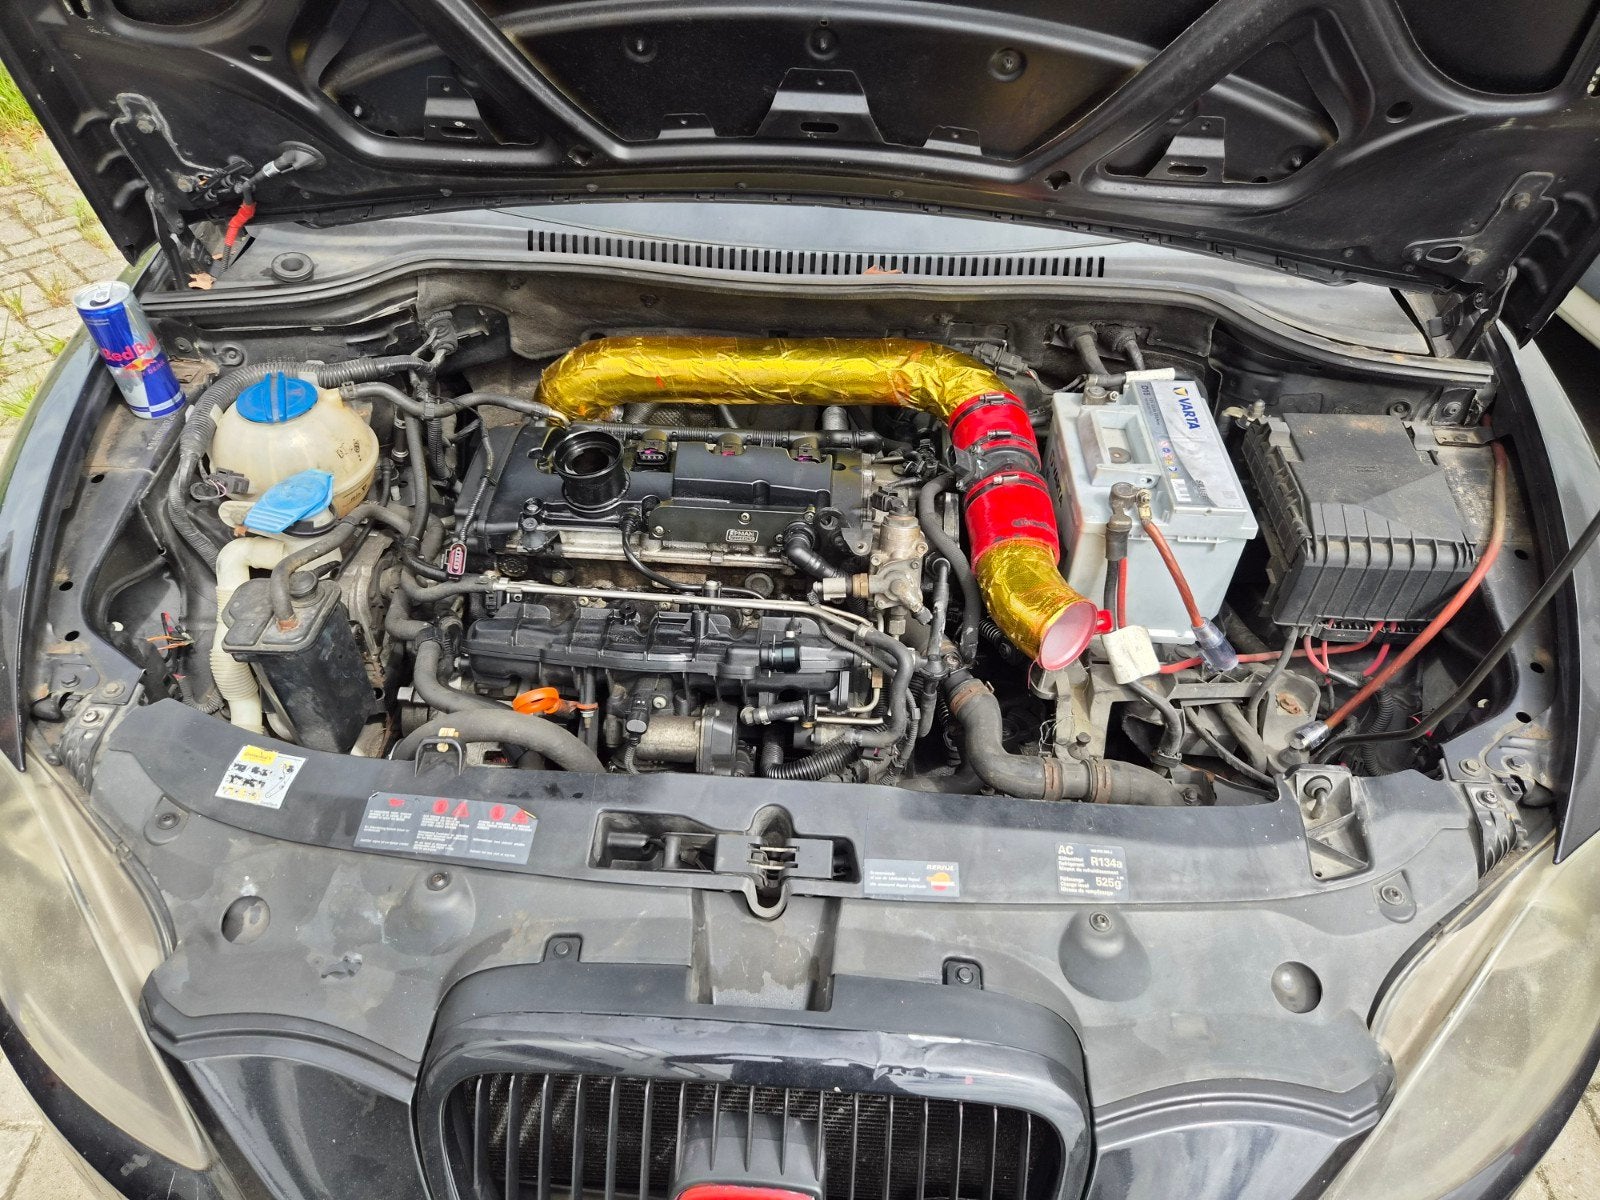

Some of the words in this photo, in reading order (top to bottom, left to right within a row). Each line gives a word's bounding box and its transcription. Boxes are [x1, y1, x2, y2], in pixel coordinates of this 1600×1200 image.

[101, 344, 136, 361] Red
[1178, 398, 1201, 429] VARTA
[1058, 845, 1074, 855] AC
[1090, 856, 1123, 868] R134a
